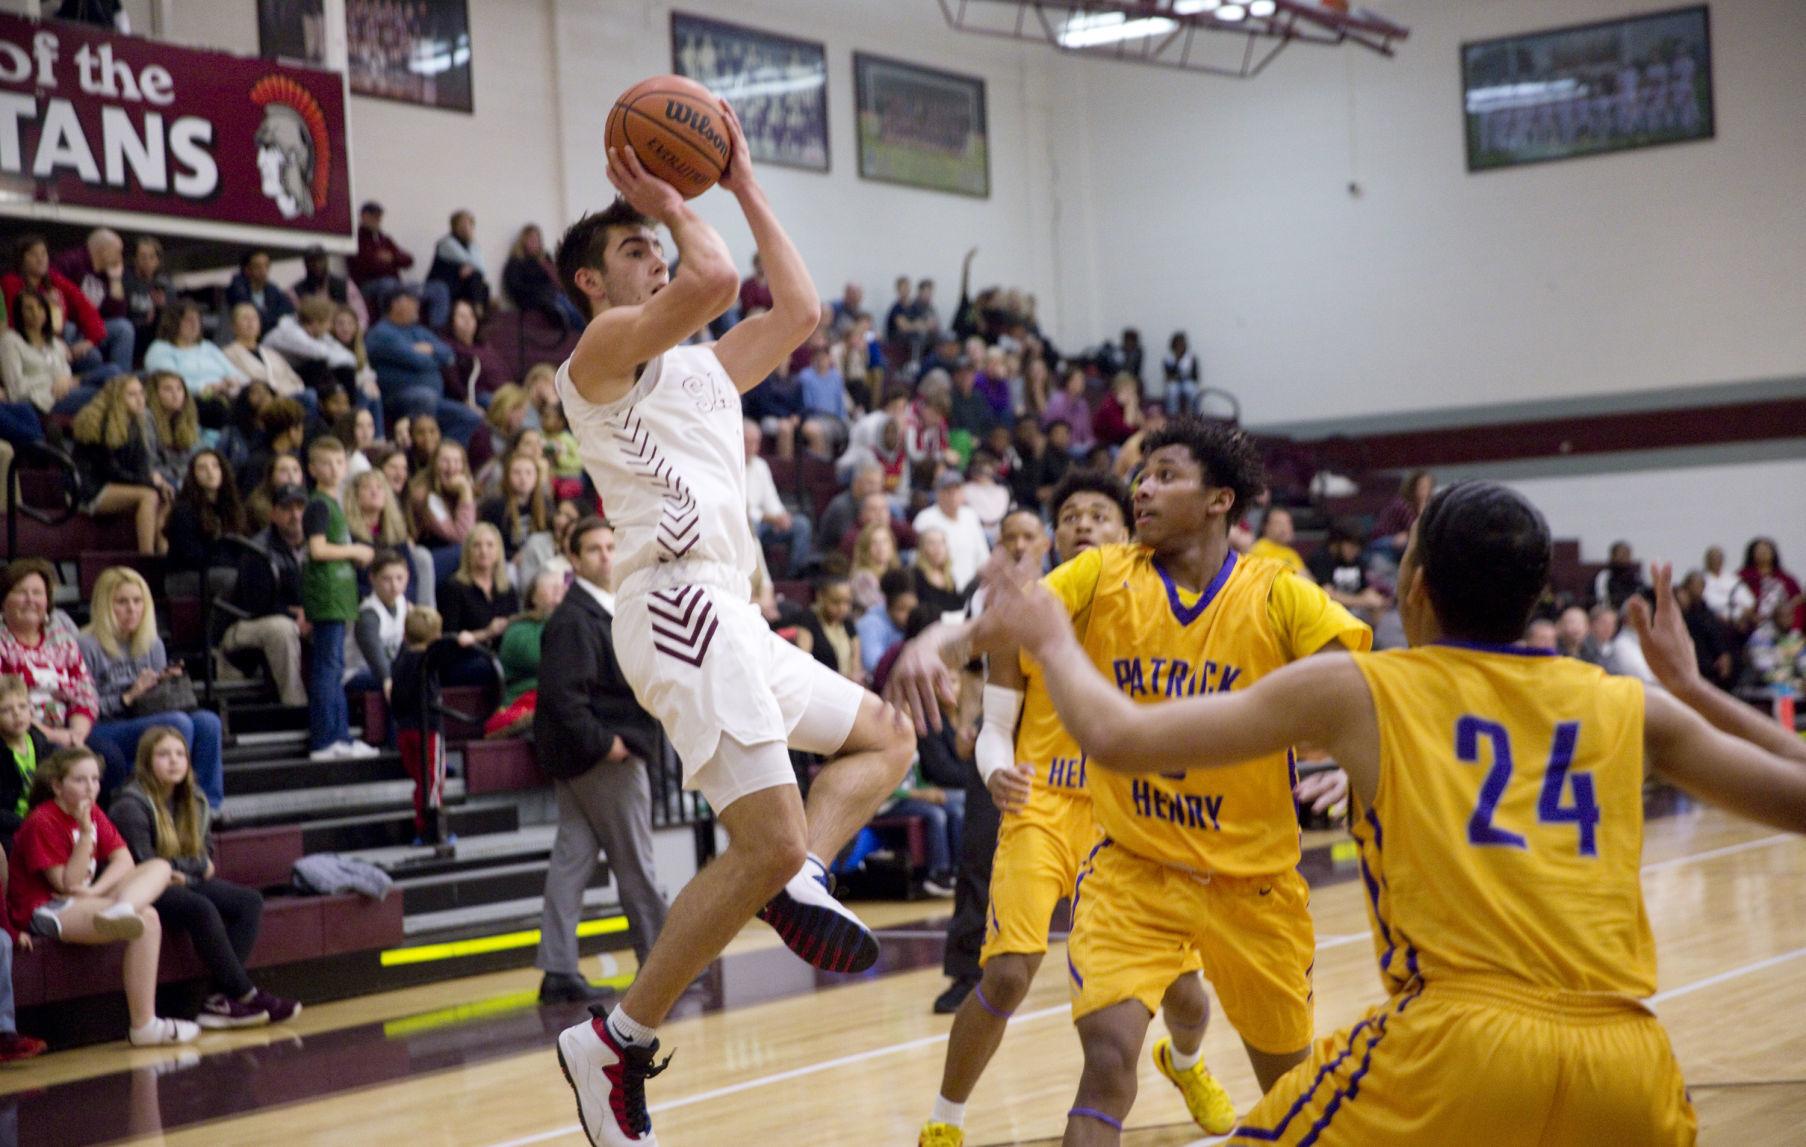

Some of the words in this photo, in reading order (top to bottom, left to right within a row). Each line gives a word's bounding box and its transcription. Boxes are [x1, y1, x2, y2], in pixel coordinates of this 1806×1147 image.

[0, 31, 60, 88] of
[75, 43, 176, 105] the
[0, 93, 218, 198] TANS
[665, 99, 727, 158] Wilson
[1113, 656, 1243, 698] PATRICK
[1132, 777, 1224, 831] HENRY
[1455, 714, 1600, 856] 24
